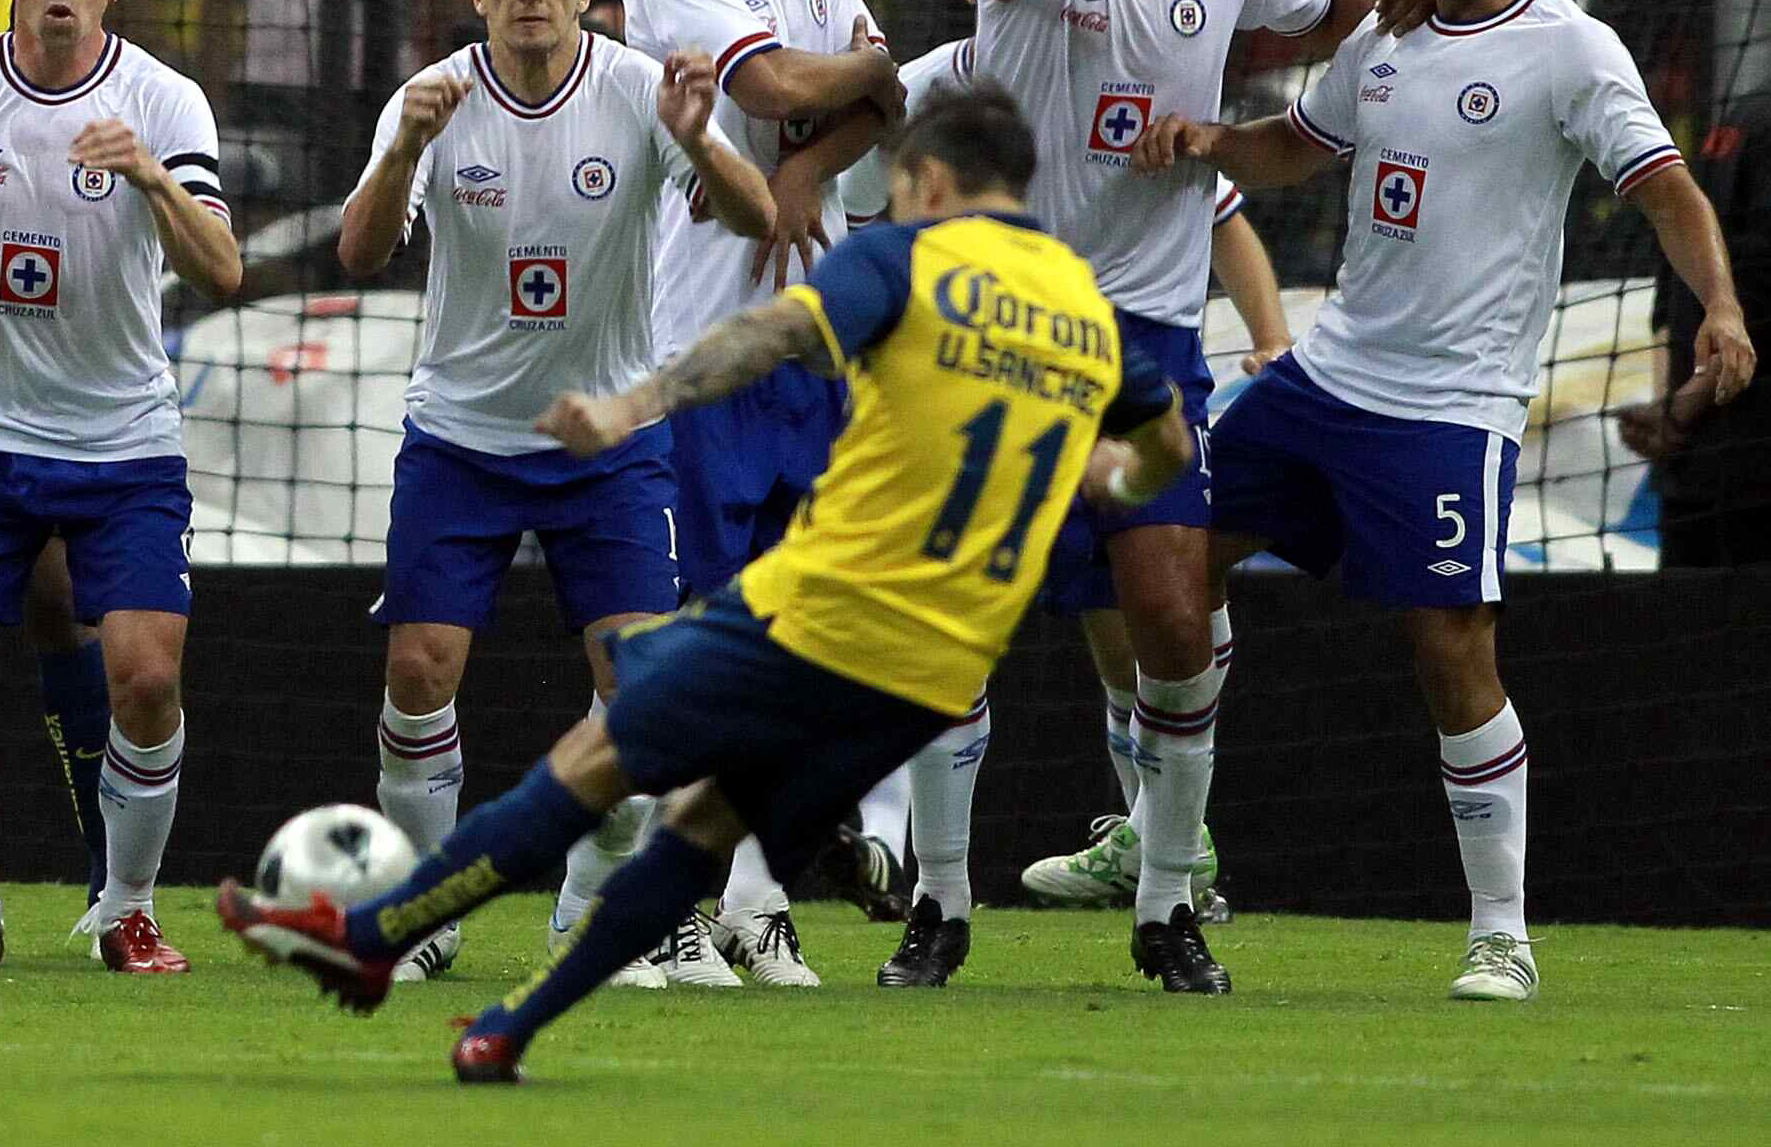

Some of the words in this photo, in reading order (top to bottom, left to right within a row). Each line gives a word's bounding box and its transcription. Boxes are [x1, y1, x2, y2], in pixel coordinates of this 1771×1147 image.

[1101, 81, 1155, 94] CEMENTO
[1380, 147, 1428, 168] CEMENTO
[3, 230, 61, 248] CEMENTO
[508, 245, 567, 259] CEMENTO
[934, 264, 1114, 365] Coron
[922, 398, 1073, 583] 11
[663, 507, 678, 562] 1
[1436, 494, 1466, 548] 5
